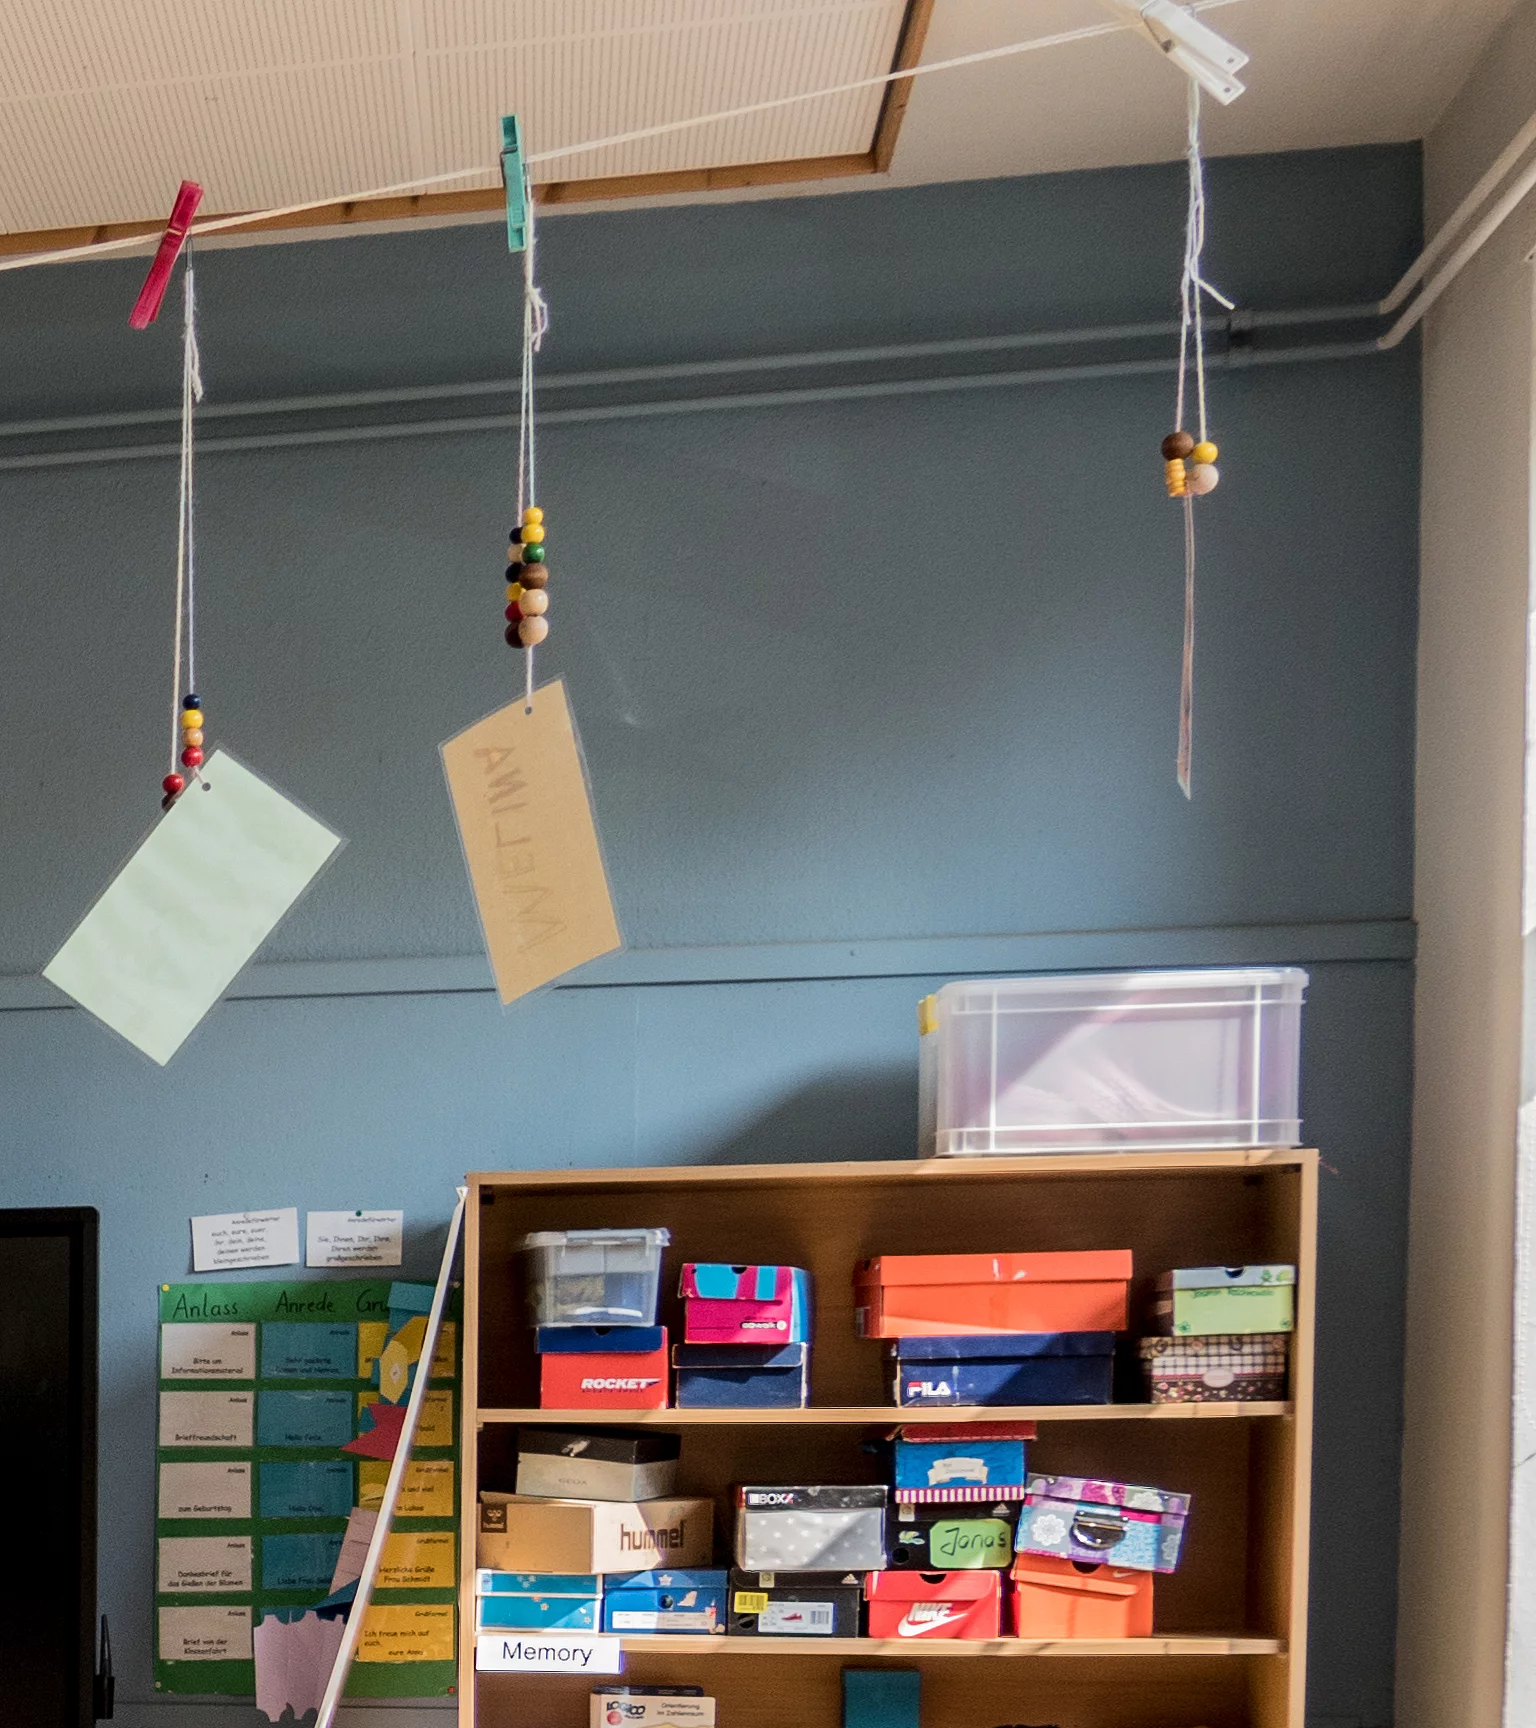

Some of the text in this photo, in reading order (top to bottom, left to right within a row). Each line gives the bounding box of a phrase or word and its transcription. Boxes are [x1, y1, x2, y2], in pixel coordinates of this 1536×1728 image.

[172, 1292, 239, 1319] Anlass
[275, 1291, 334, 1314] Anrede
[580, 1377, 651, 1391] ROCKET
[907, 1381, 952, 1398] FILA
[620, 1521, 685, 1551] hummel
[940, 1526, 1007, 1556] Jonas
[907, 1602, 954, 1622] NIKE
[502, 1641, 594, 1667] Memory
[661, 1702, 701, 1711] Orientierung
[666, 1710, 705, 1718] Zahlenraum
